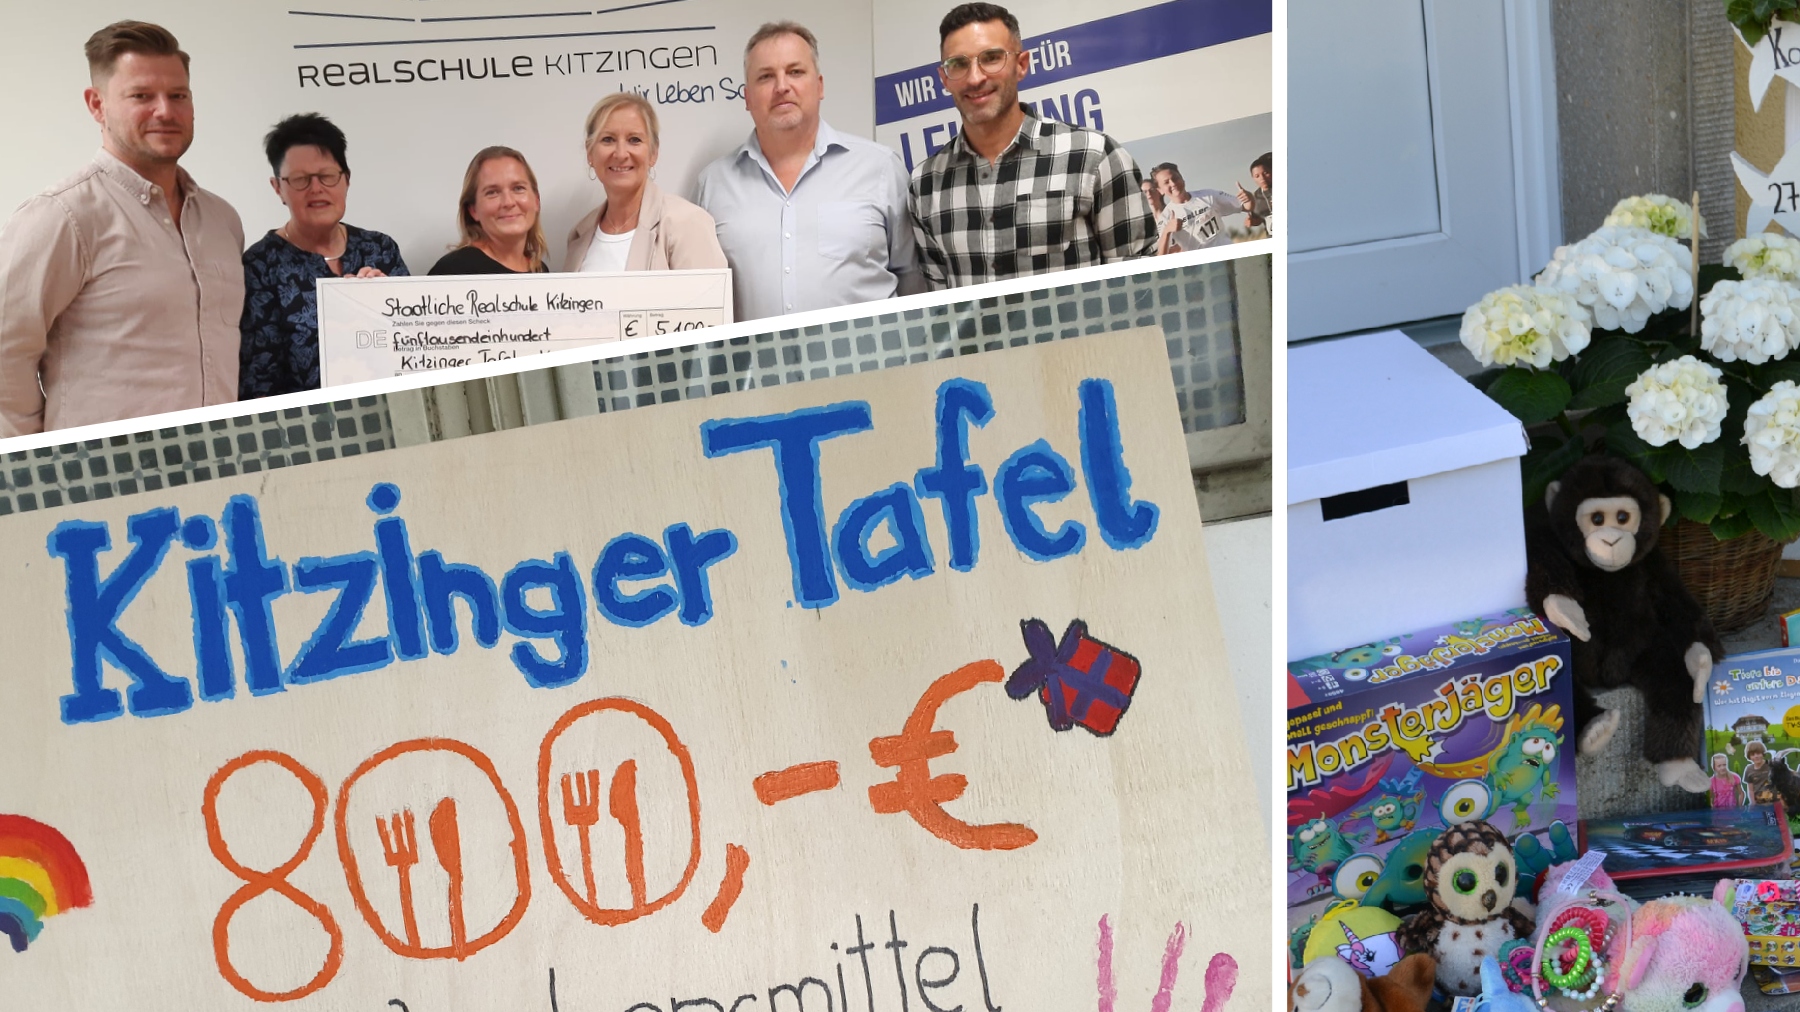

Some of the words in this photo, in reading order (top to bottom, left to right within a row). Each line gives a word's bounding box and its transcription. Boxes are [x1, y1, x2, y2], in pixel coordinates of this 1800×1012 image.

[895, 73, 937, 108] WIR
[1028, 40, 1072, 75] FÜR
[1199, 216, 1220, 238] 177
[381, 295, 465, 317] Staatliche
[466, 288, 540, 314] Realschule
[546, 292, 604, 313] Kitzingen
[624, 321, 639, 337] €
[400, 354, 472, 371] Kitzinger
[47, 483, 738, 724] Kitzinger
[700, 378, 1160, 610] Tafel
[1287, 655, 1562, 788] Monsterjäger
[1323, 700, 1343, 715] und
[867, 658, 1039, 851] €
